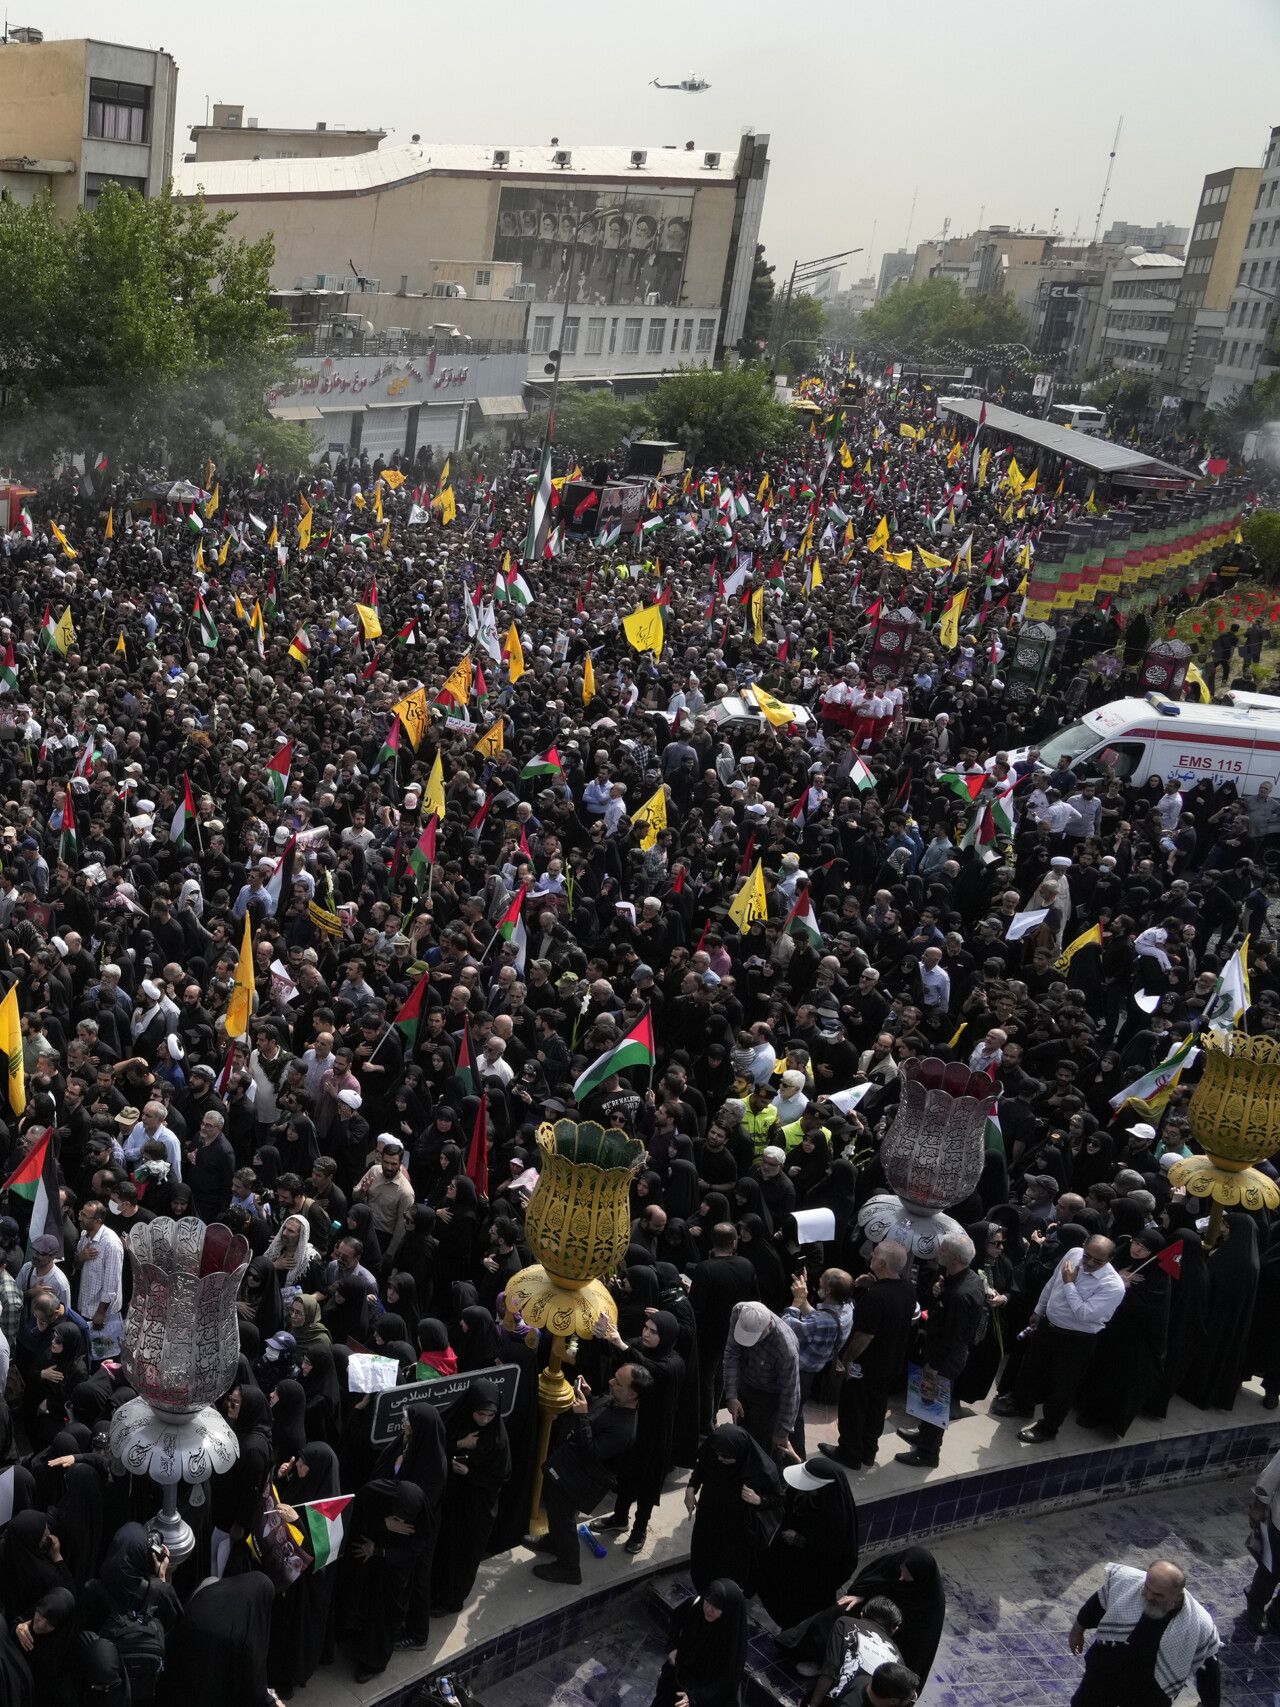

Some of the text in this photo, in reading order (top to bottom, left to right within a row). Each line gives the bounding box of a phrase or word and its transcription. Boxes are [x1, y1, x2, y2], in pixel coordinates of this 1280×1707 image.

[352, 369, 367, 393] مرغ
[1179, 755, 1242, 772] EMS 115
[1167, 769, 1196, 782] تهران
[620, 1096, 641, 1104] WALKING
[433, 1381, 470, 1398] انقلاب
[390, 1388, 432, 1409] اسلامی
